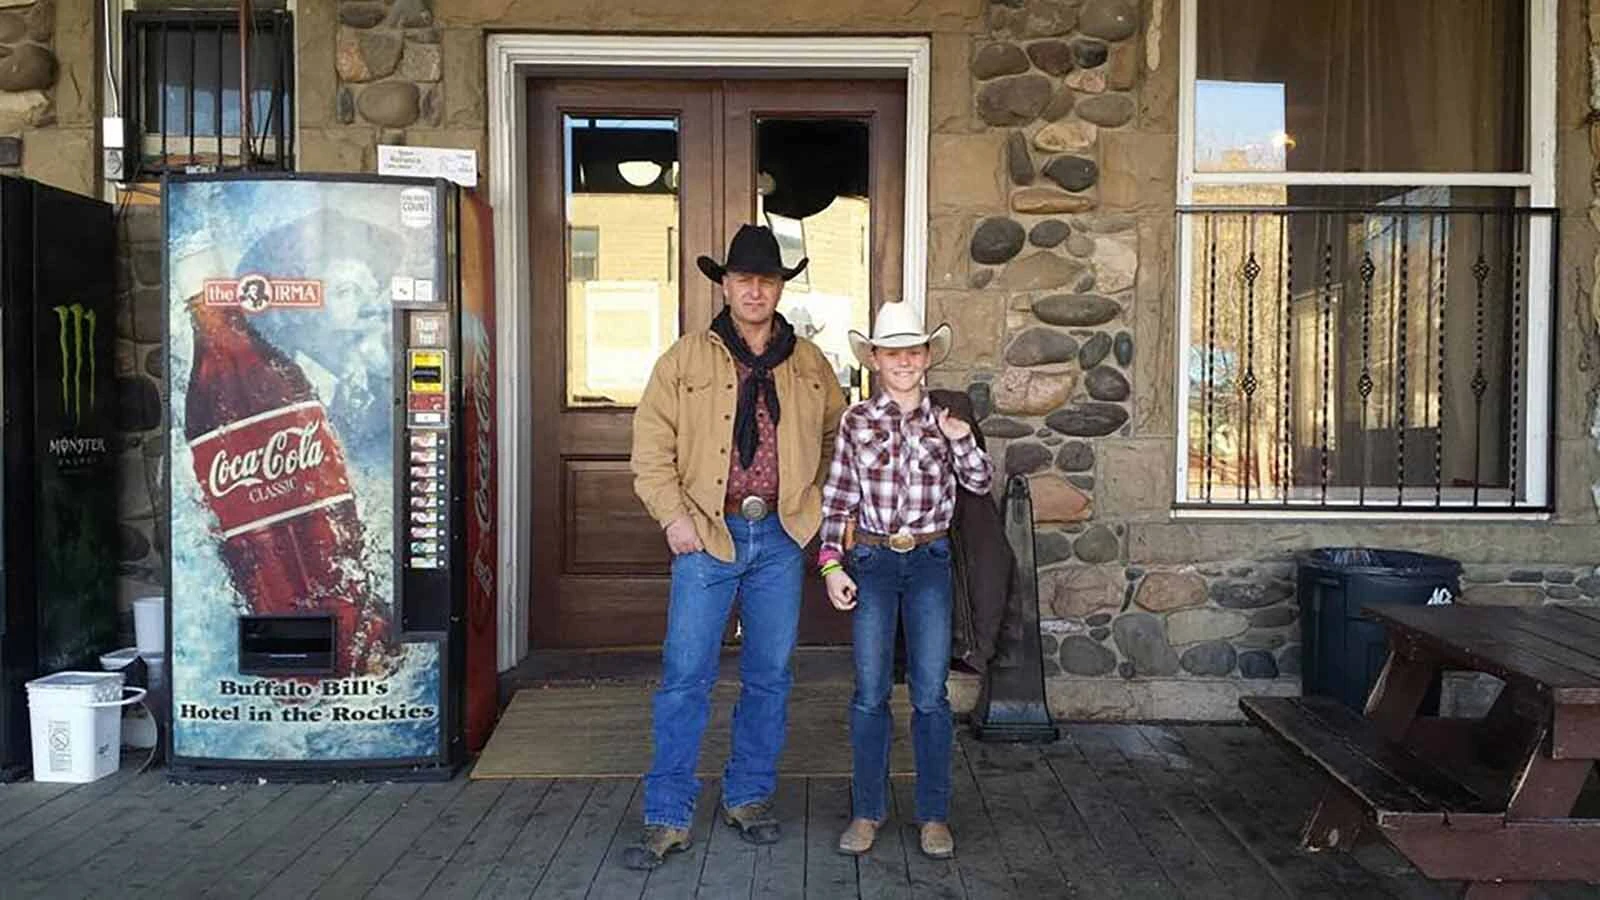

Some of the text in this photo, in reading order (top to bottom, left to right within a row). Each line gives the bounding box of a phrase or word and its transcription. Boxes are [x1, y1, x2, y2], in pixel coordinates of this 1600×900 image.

[208, 284, 316, 302] the IRMA
[48, 436, 106, 456] MONSTER
[209, 418, 324, 498] Coca-Cola
[248, 476, 298, 503] CLASSIC
[219, 679, 389, 698] Buffalo Bill's
[180, 702, 435, 722] Hotel in the Rockies
